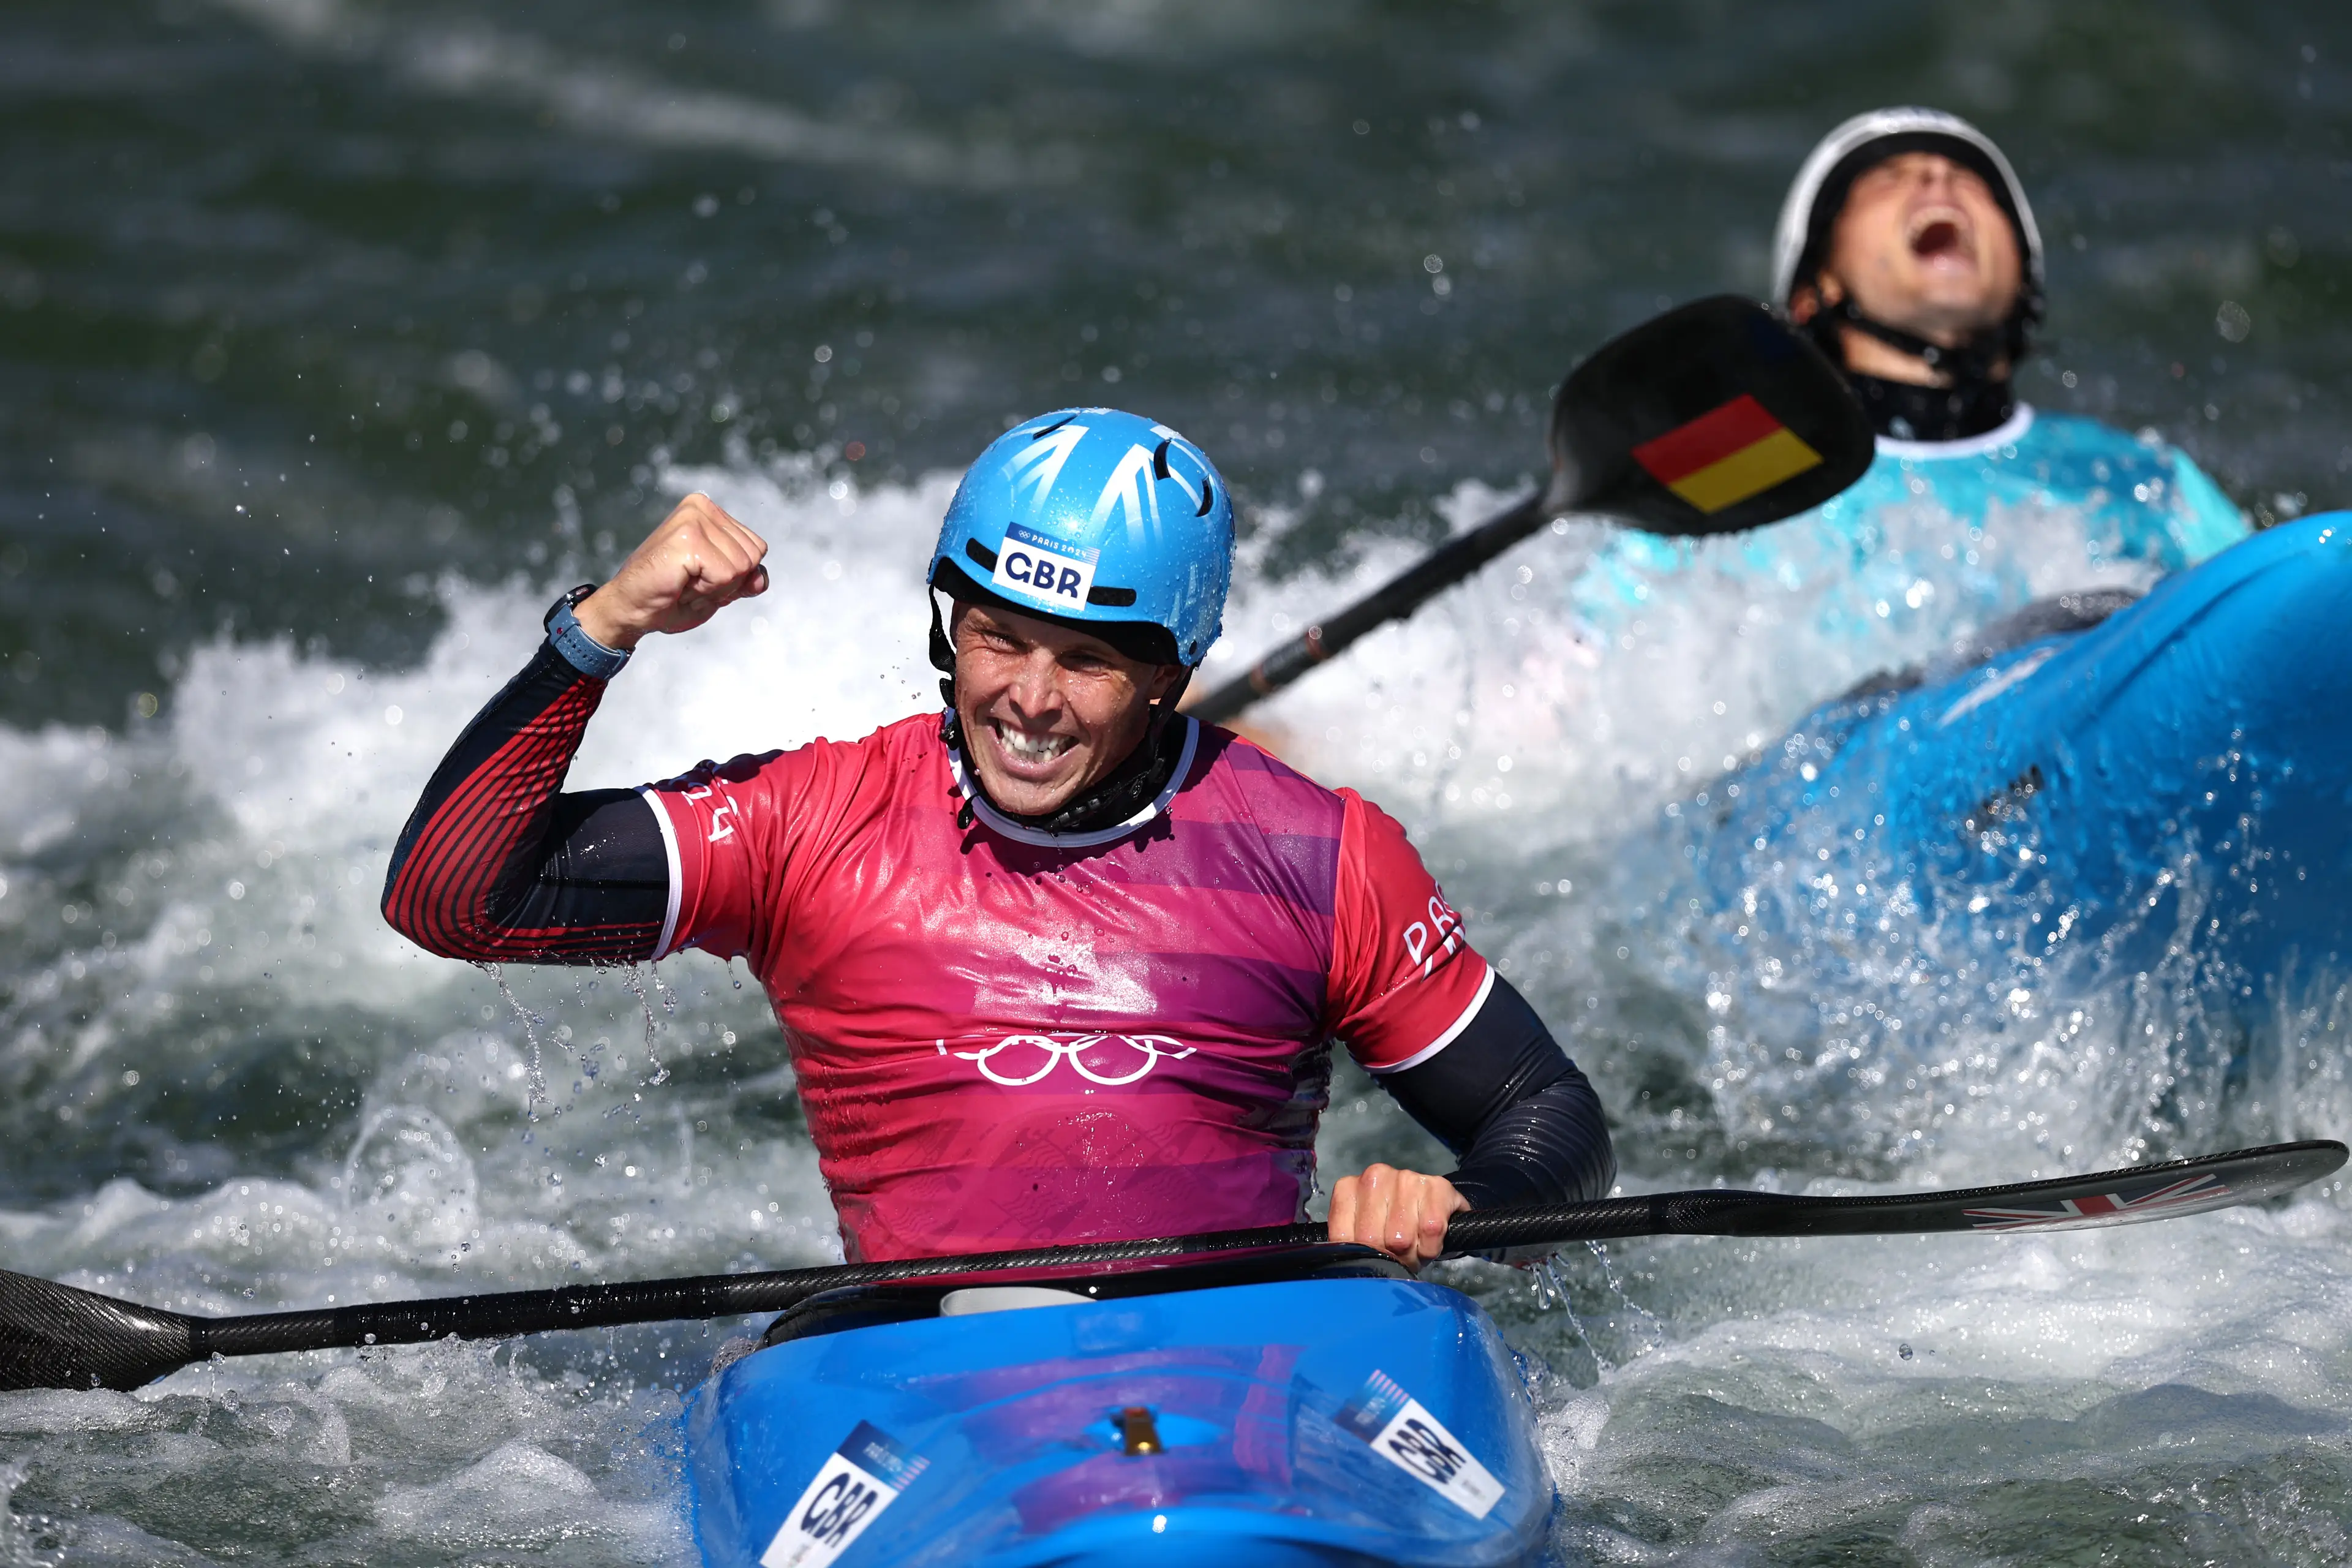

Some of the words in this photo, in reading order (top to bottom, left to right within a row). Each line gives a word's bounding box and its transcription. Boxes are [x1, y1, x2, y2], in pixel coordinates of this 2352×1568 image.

[1032, 535, 1059, 549] PARIS
[1061, 545, 1087, 558] 2024
[1005, 552, 1082, 599] GBR
[1388, 1418, 1467, 1485] GBR
[801, 1472, 878, 1549] GBR
